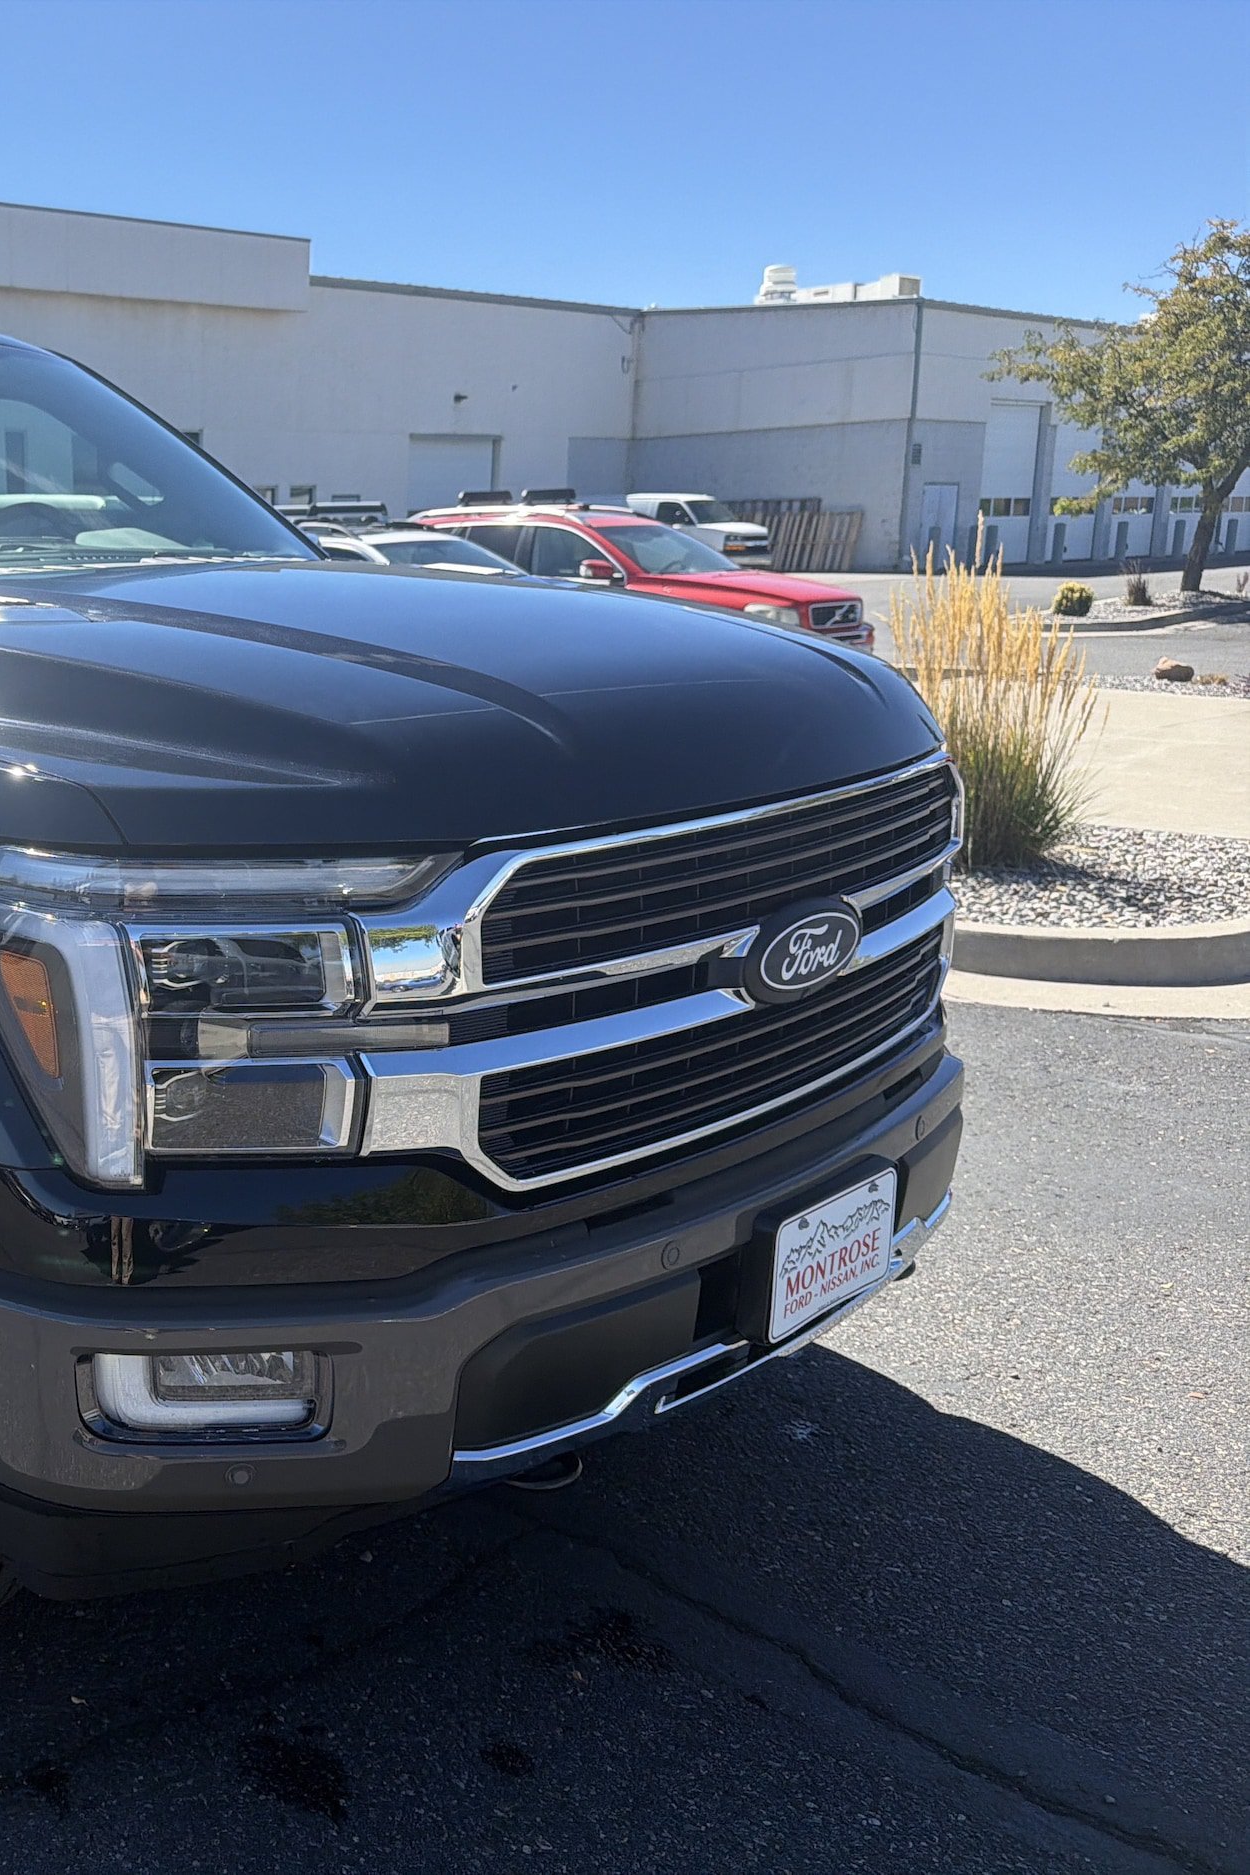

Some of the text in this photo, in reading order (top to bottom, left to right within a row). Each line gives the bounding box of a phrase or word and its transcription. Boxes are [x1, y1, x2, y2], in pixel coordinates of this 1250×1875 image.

[781, 924, 843, 981] Ford
[785, 1227, 882, 1301] MONTROSE
[860, 1253, 880, 1275] INC.
